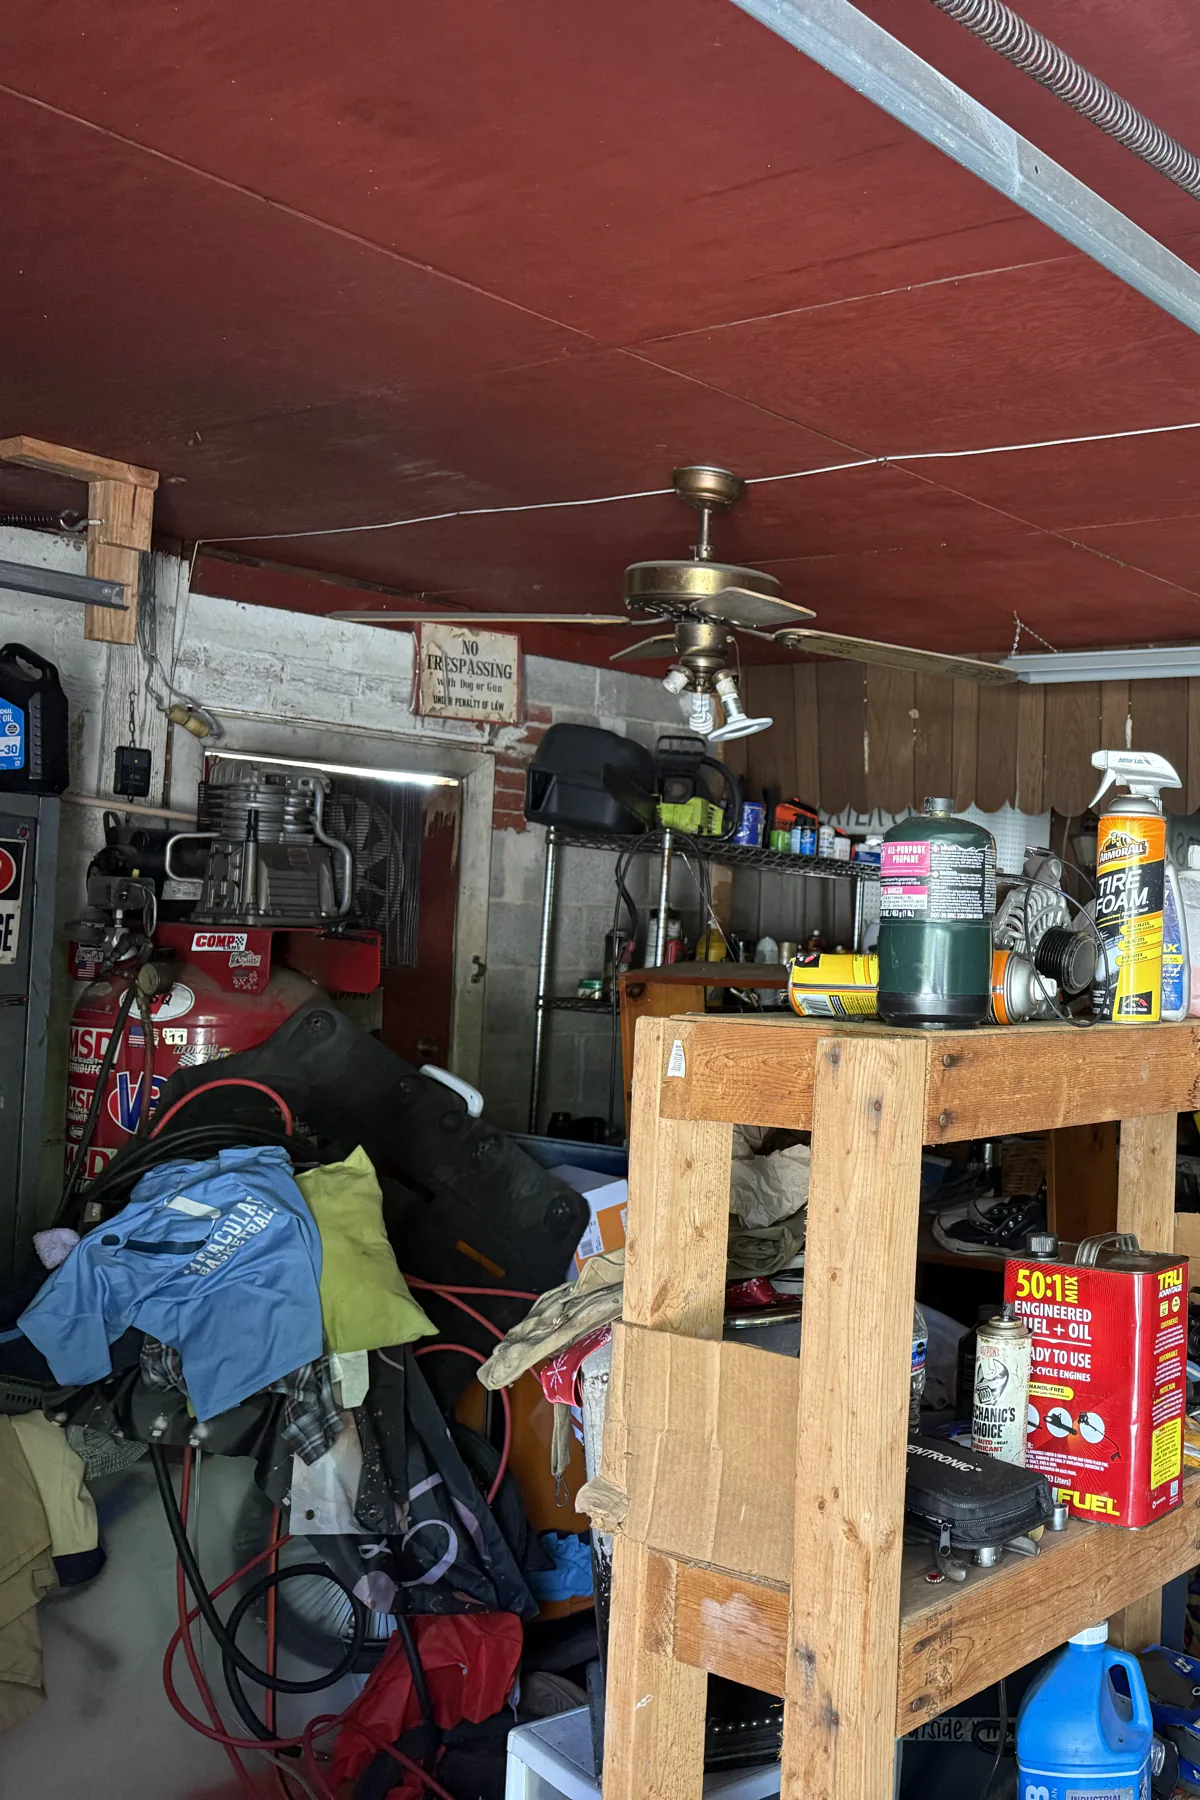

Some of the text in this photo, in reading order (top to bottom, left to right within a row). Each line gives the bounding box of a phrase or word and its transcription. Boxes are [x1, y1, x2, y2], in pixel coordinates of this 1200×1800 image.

[461, 640, 479, 656] NO
[426, 654, 513, 680] TRESPASSING
[437, 678, 456, 687] Wth
[460, 679, 474, 692] Dog
[487, 682, 503, 693] Gun
[455, 697, 480, 709] PENALTY
[482, 700, 489, 709] OF
[491, 700, 505, 711] LAW
[887, 845, 926, 854] ALL-PURPOSE
[892, 855, 919, 863] PROPANE
[1099, 869, 1142, 896] TIRE
[1096, 887, 1149, 917] FOAM
[195, 935, 236, 948] COMP
[169, 1034, 184, 1043] 11
[200, 1208, 278, 1276] BASKETBAL
[1016, 1269, 1062, 1301] 50:1
[1157, 1267, 1183, 1291] TRU
[1064, 1275, 1078, 1304] MIX
[1158, 1286, 1182, 1299] ADVANTAGE
[1014, 1300, 1092, 1322] ENGINEERED
[1068, 1323, 1092, 1340] OIL
[1030, 1347, 1092, 1368] ADY TO USE
[1028, 1366, 1091, 1382] 2-CYCLE ENGINES
[973, 1423, 1003, 1439] CHOICE
[1053, 1487, 1120, 1517] FUEL
